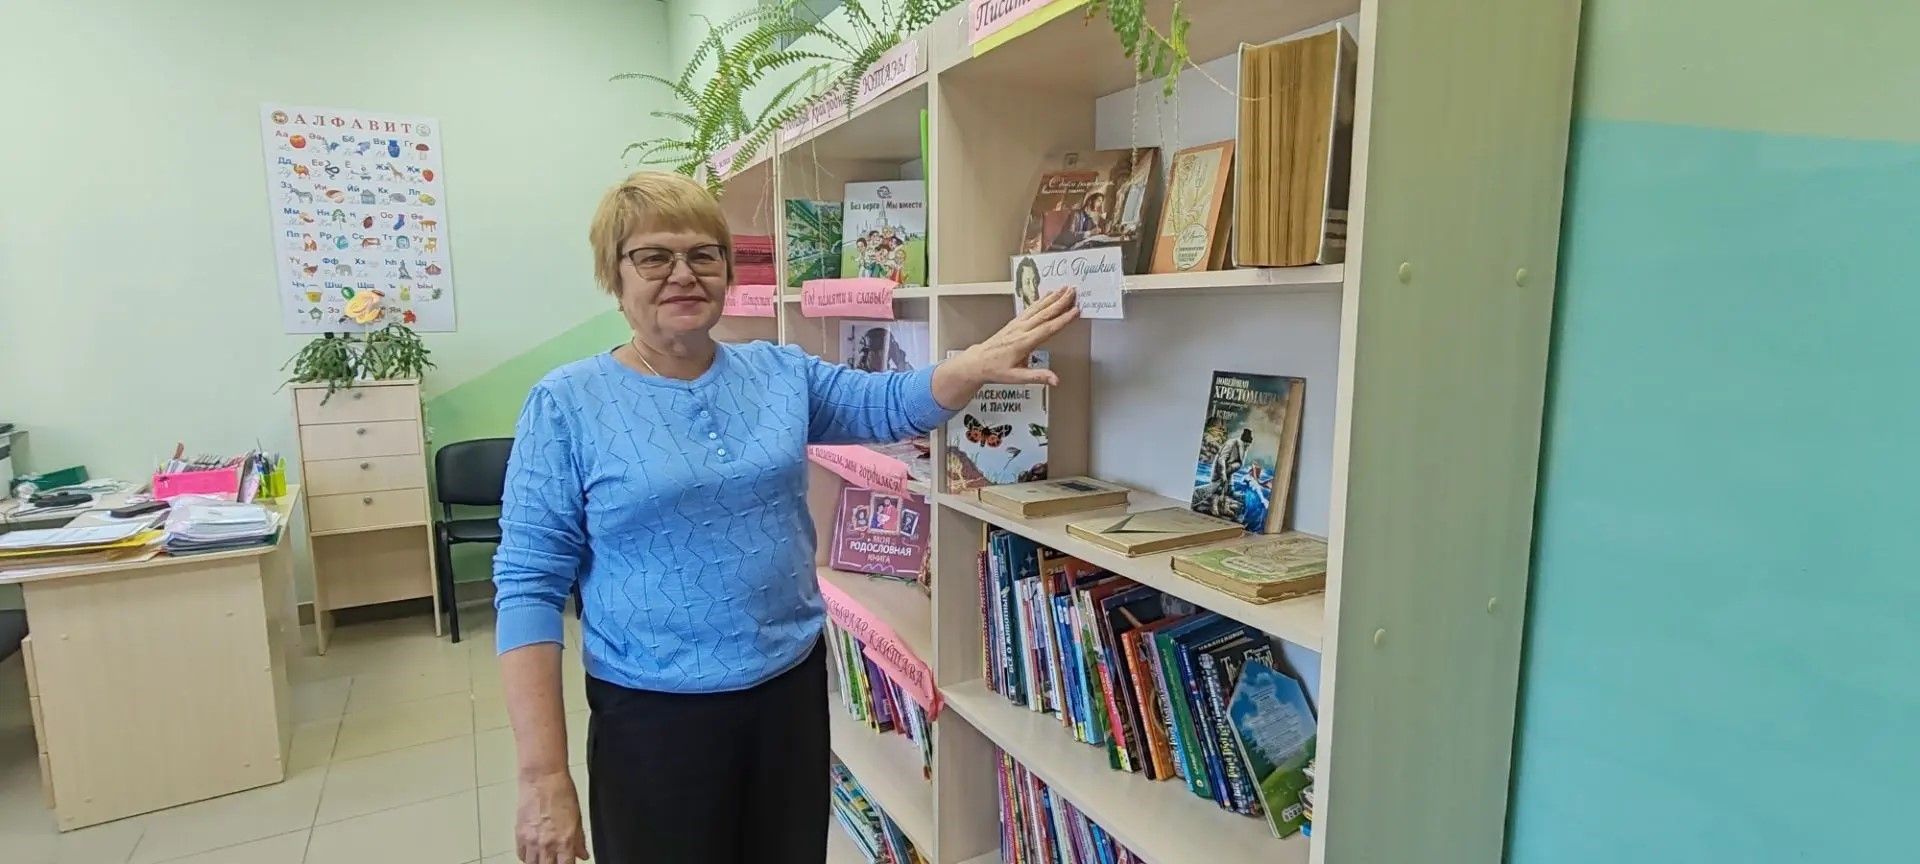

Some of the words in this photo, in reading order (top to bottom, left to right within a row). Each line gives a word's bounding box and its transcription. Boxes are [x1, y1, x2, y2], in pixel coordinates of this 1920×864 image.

[976, 0, 1031, 31] Писат
[294, 113, 412, 134] АЛФАВИТ
[1071, 255, 1117, 282] Пушкин
[817, 294, 846, 307] памяти
[1214, 385, 1281, 405] ХРЕСТОМАТИ
[980, 402, 987, 412] И
[990, 402, 1022, 412] ПАУКИ
[850, 540, 912, 557] РОДОСЛОВНАЯ
[873, 535, 891, 544] МОЯ
[867, 554, 891, 564] КНИГА
[822, 593, 869, 636] СЫРЛАР
